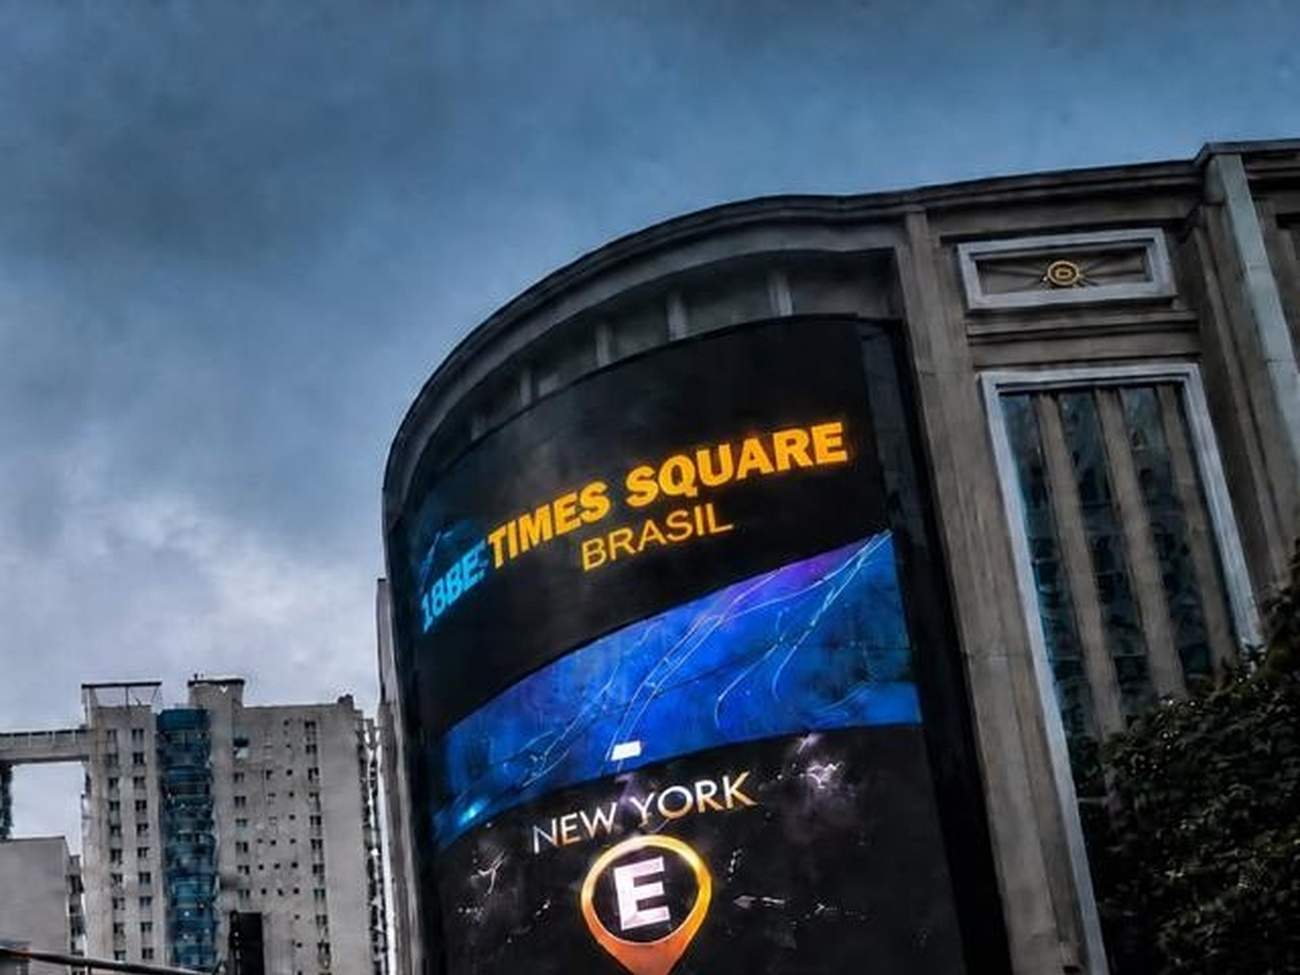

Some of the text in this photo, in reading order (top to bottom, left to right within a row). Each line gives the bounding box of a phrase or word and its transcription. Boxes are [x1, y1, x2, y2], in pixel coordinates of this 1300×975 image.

[487, 482, 610, 568] TIMES
[626, 421, 849, 507] SQUARE
[581, 503, 734, 572] BRASIL
[532, 771, 757, 854] NEW YORK
[613, 857, 671, 931] E
